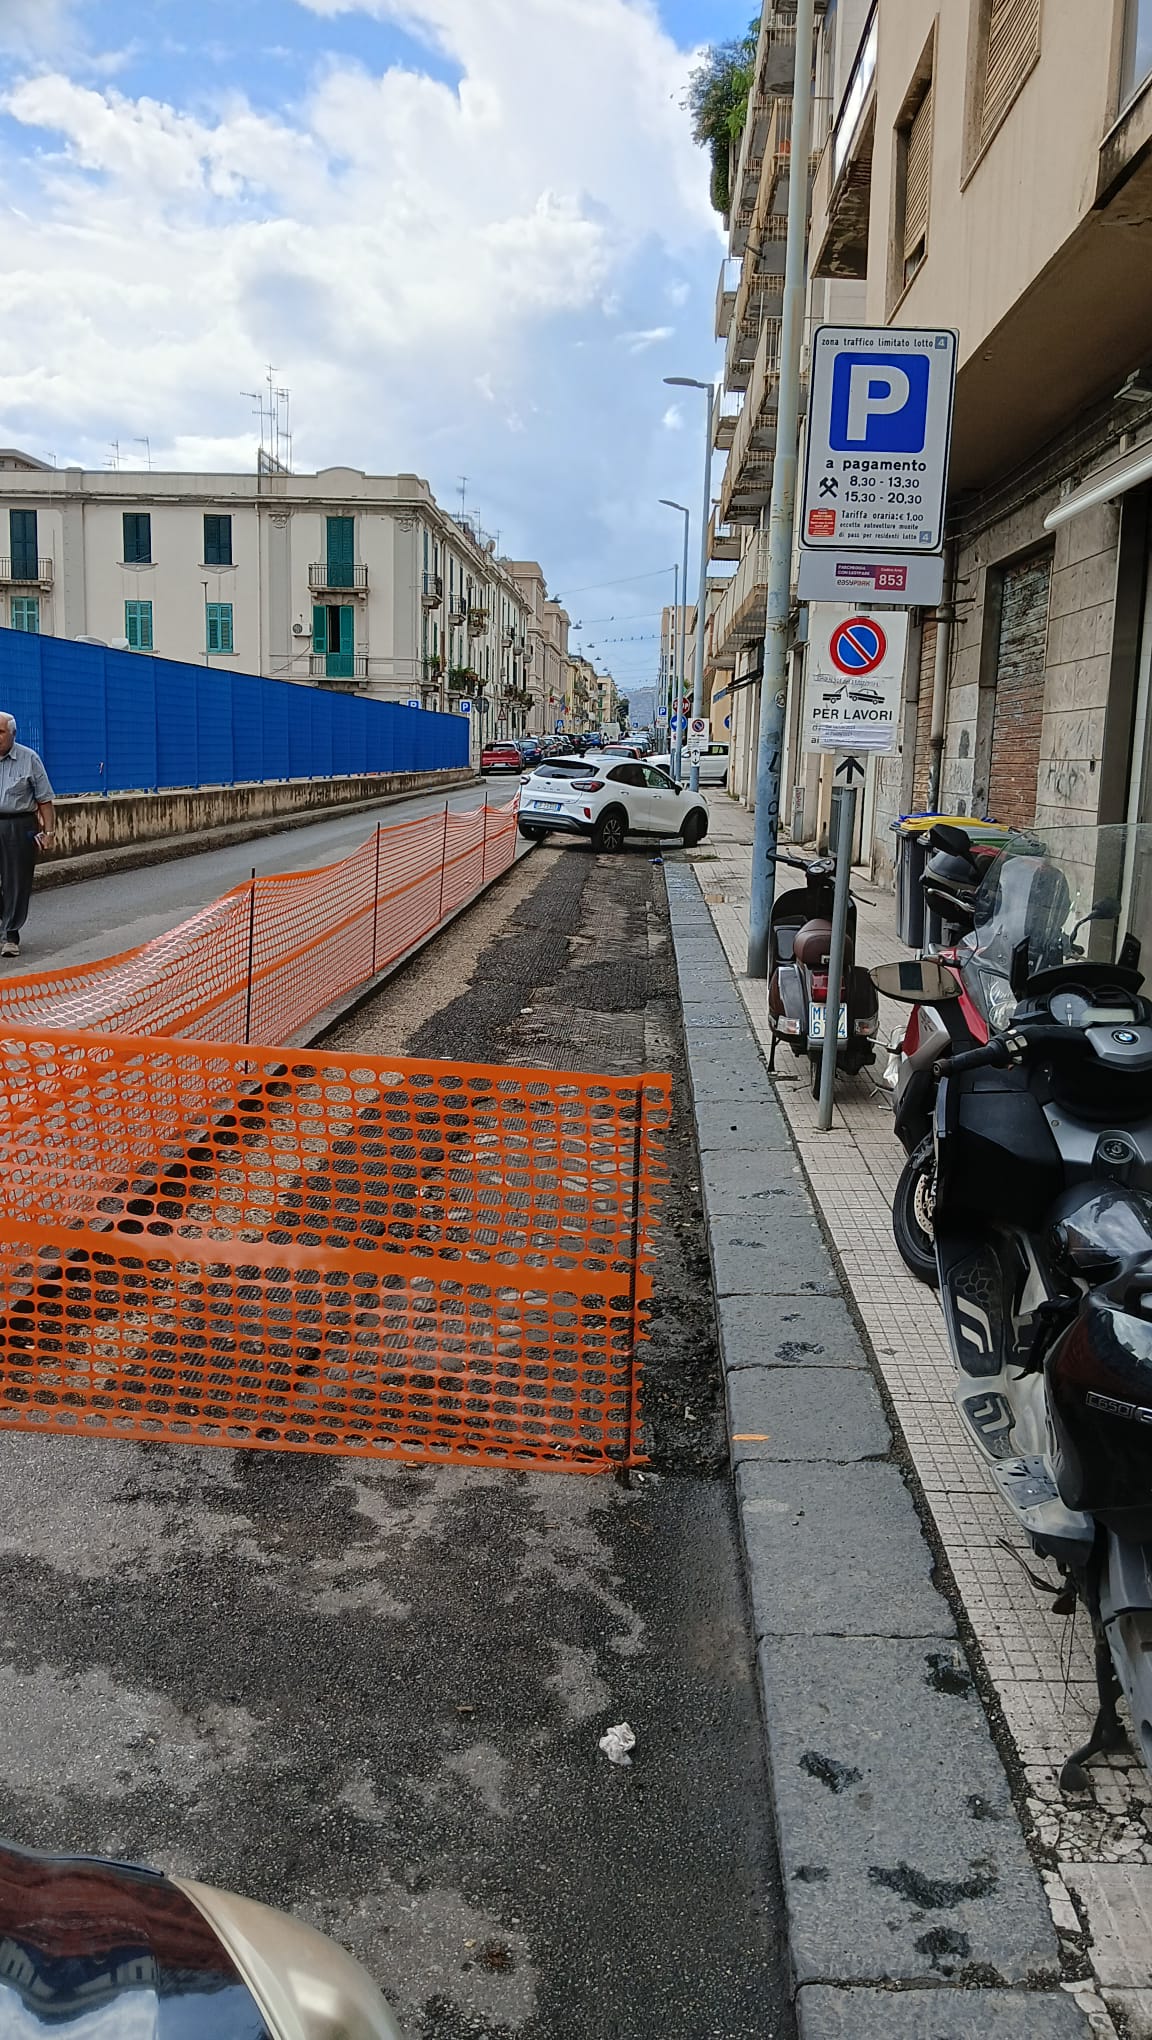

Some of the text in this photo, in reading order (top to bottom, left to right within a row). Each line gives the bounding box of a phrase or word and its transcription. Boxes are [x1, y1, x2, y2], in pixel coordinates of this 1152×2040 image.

[822, 338, 839, 346] zona
[843, 337, 874, 346] traffico
[878, 337, 910, 347] limitato
[913, 338, 933, 348] lotto
[846, 364, 910, 442] P
[825, 459, 927, 471] a pagamento
[841, 510, 867, 519] Tariffa
[878, 574, 904, 586] 853
[463, 702, 469, 711] P
[812, 708, 893, 721] PER LAVORI
